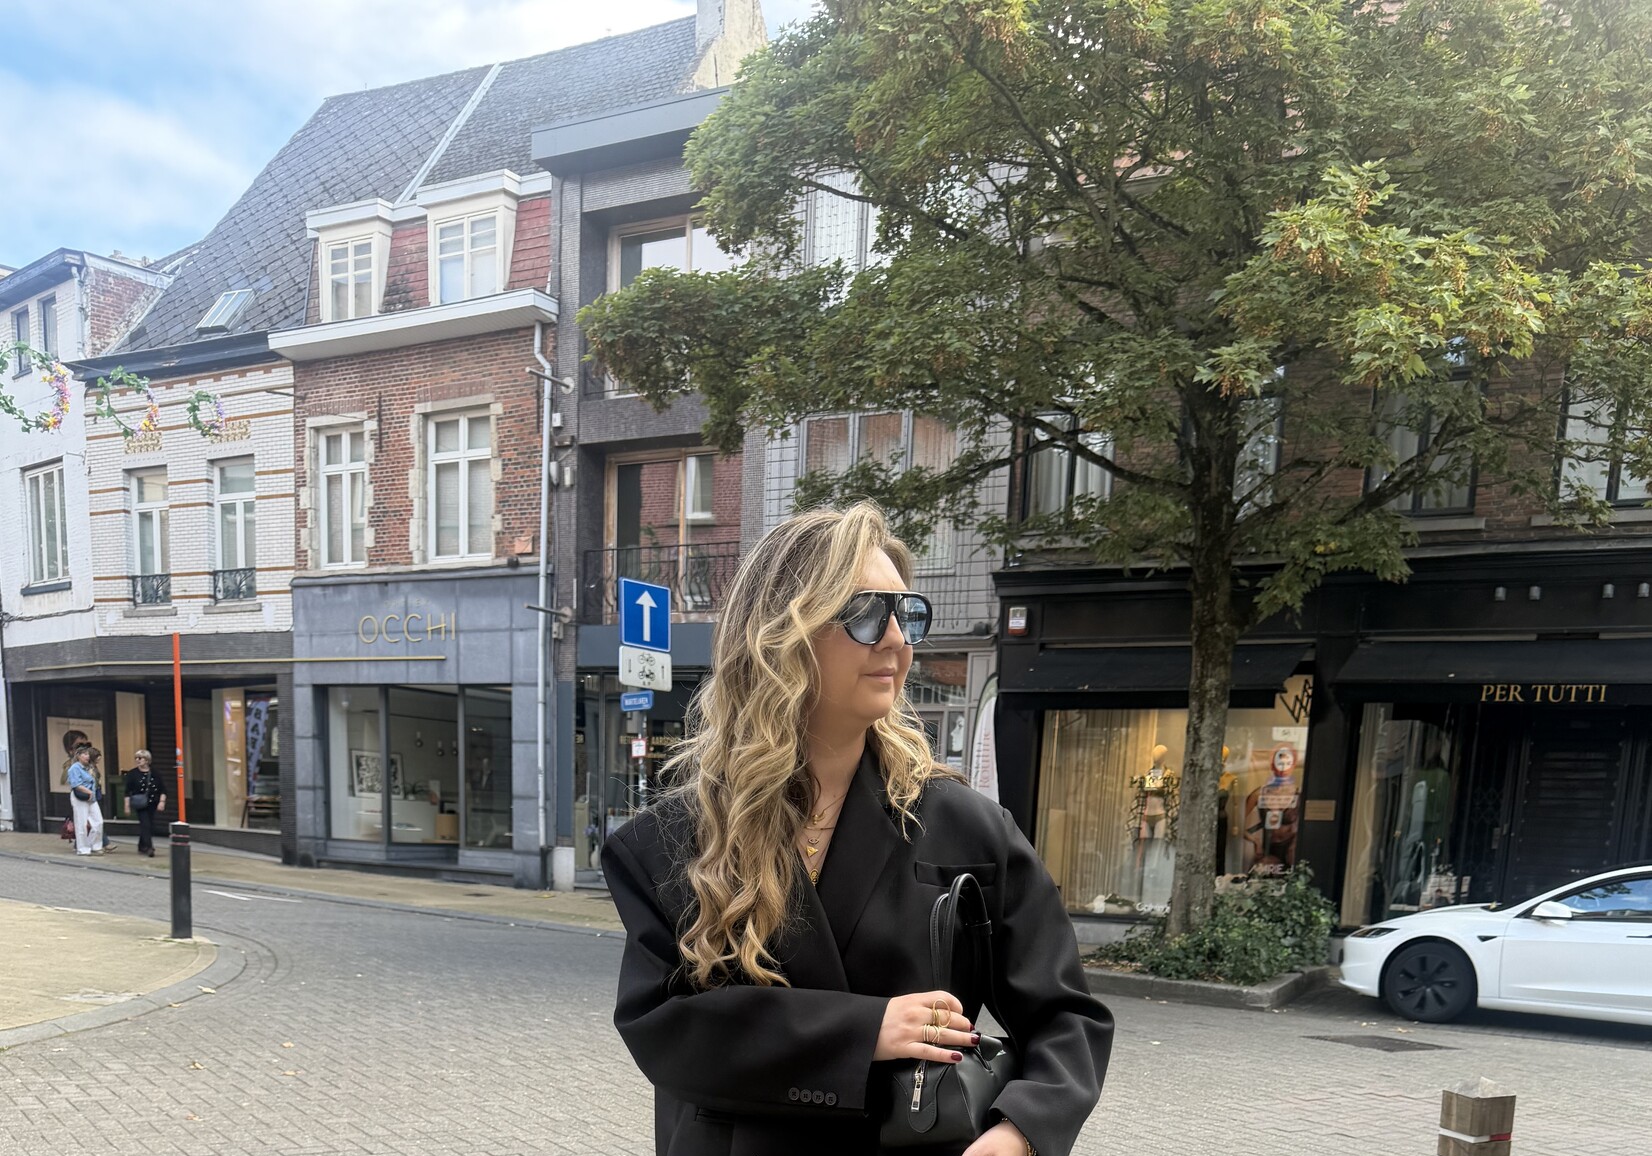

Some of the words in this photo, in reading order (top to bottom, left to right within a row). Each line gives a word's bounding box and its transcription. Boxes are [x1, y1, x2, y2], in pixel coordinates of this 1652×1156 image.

[359, 612, 456, 644] OCCHI
[1480, 684, 1525, 702] PER
[1531, 684, 1608, 703] TUTTI
